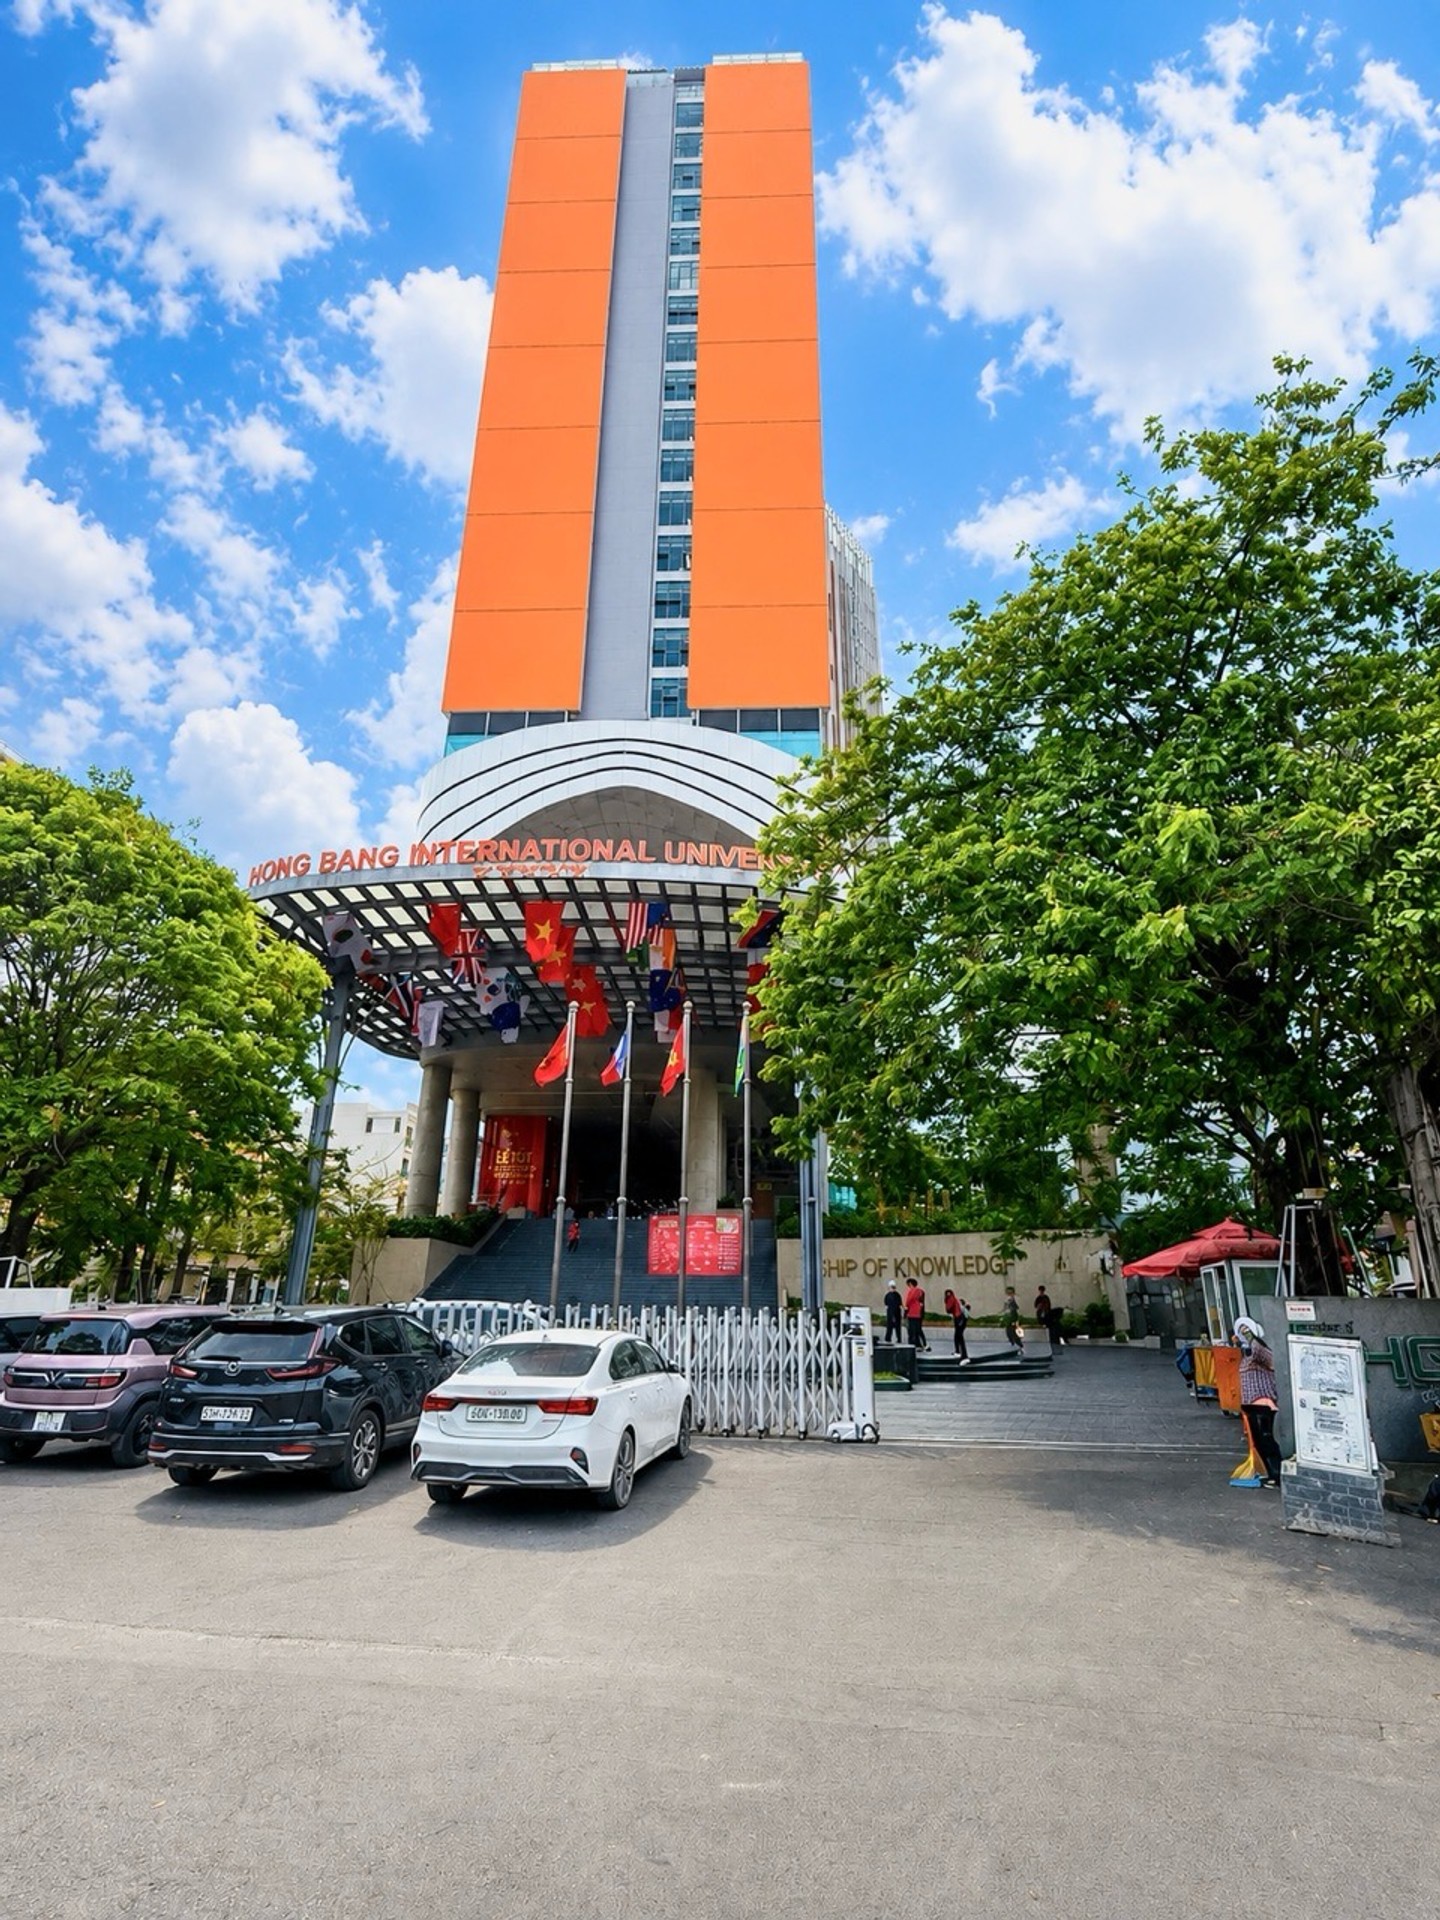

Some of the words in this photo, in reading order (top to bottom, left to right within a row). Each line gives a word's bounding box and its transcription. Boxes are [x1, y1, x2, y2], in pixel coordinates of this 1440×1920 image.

[249, 853, 311, 887] HONG
[319, 844, 400, 874] BANG
[409, 838, 656, 867] INTERNATIONAL
[863, 1258, 888, 1277] OF
